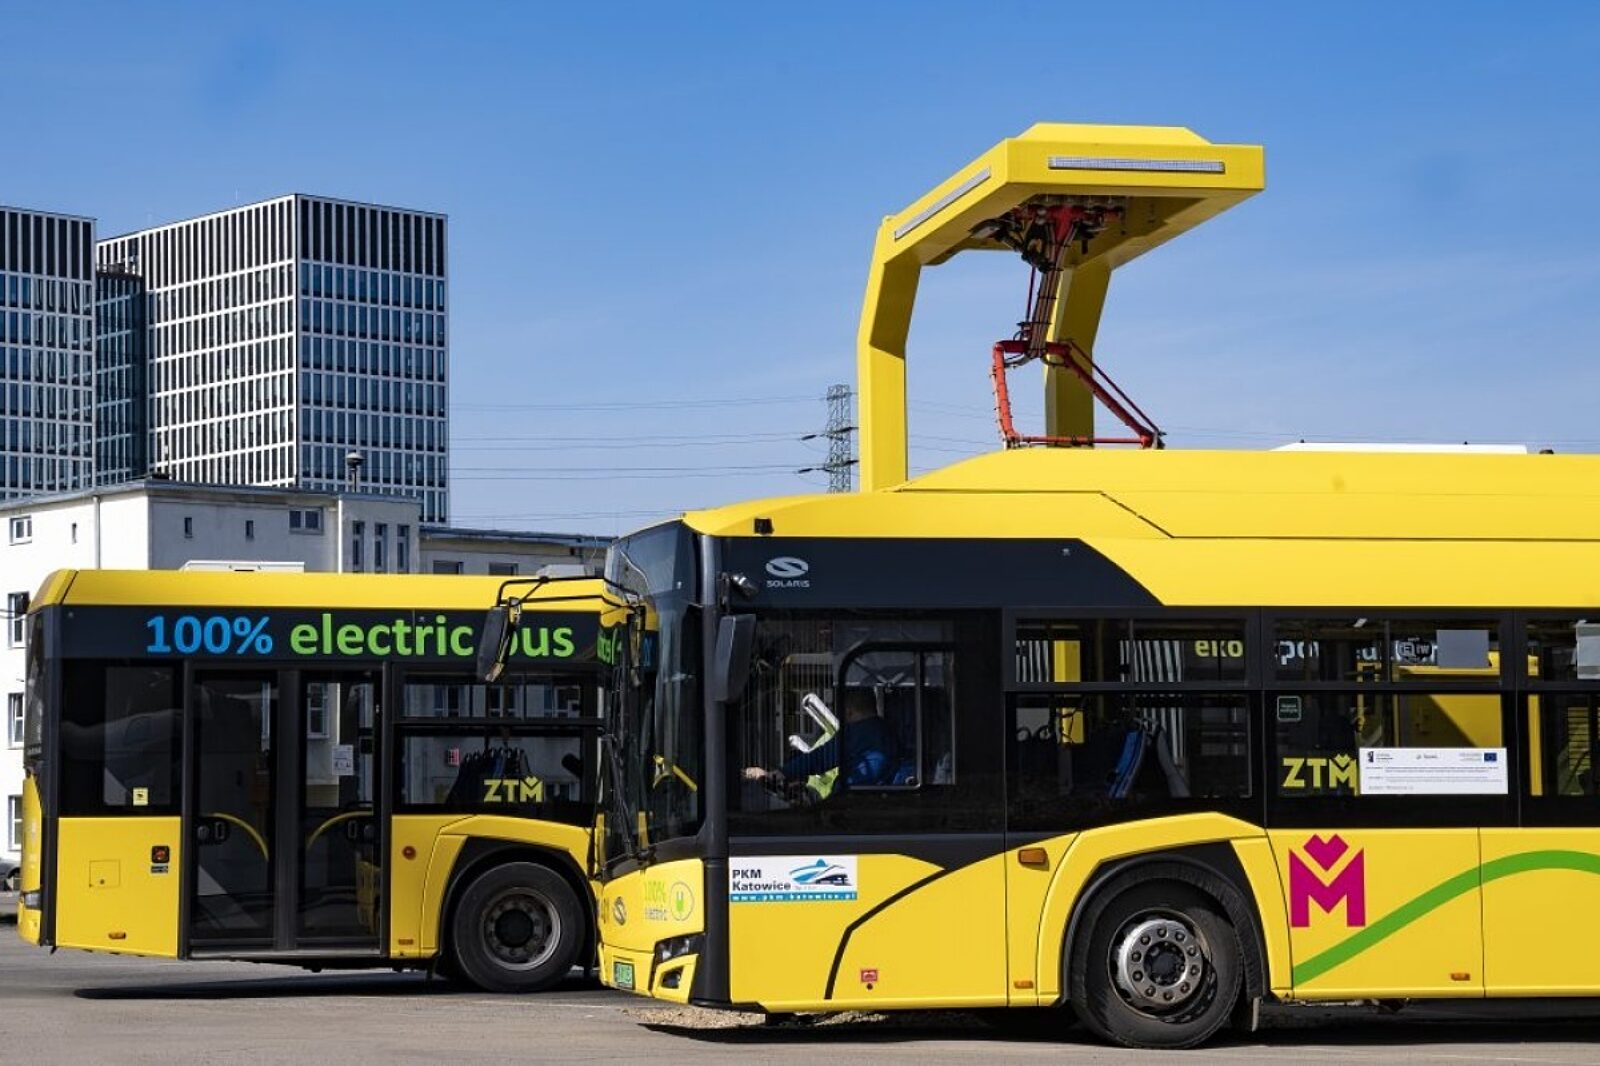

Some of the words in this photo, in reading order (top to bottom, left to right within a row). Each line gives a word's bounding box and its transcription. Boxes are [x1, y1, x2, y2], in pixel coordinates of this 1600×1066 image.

[766, 580, 810, 588] SOLARIS
[146, 615, 273, 655] 100%
[289, 613, 475, 656] electric
[1282, 754, 1357, 788] ZTM
[483, 775, 543, 803] ZTM
[732, 869, 762, 879] PKM
[732, 881, 791, 891] Katowice
